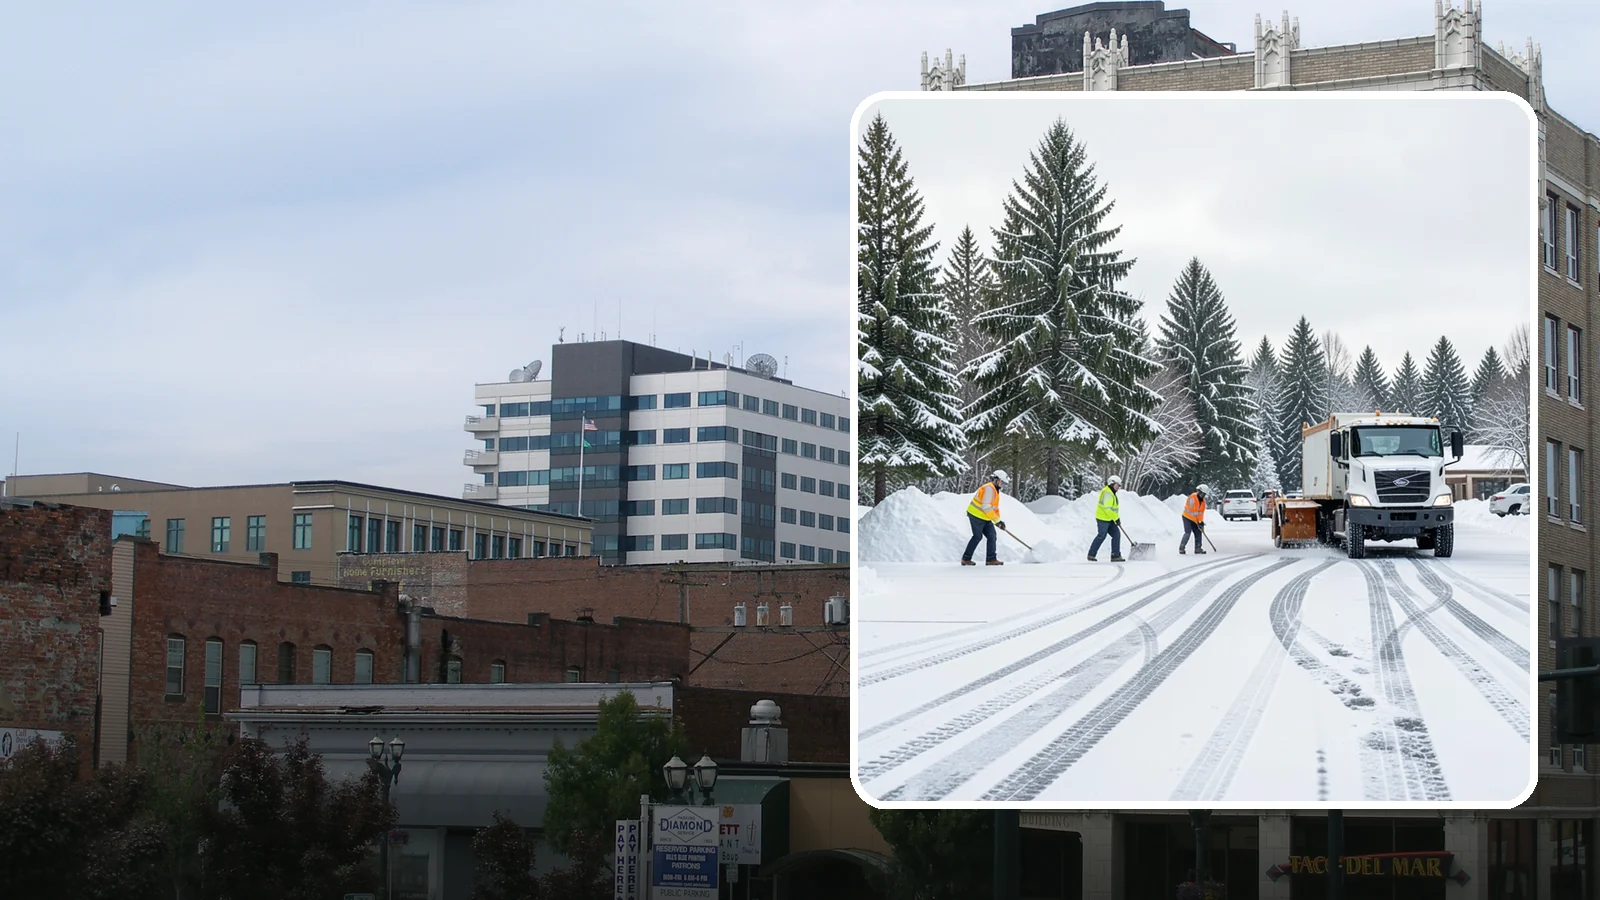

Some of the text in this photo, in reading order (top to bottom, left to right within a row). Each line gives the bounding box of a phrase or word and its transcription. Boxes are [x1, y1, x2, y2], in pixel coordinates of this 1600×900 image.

[370, 566, 427, 576] Furnishers
[660, 818, 713, 832] DIAMOND
[1022, 815, 1070, 828] BUILDING
[719, 824, 740, 835] ETT
[617, 825, 625, 852] PAY
[628, 824, 637, 852] PAY
[656, 845, 688, 853] RESERVED
[721, 851, 739, 861] Soup
[671, 862, 701, 870] PATRONS
[1289, 855, 1442, 877] TAC DEL MAR
[617, 856, 625, 894] HERE
[628, 855, 636, 893] HERE
[660, 888, 710, 898] PUBLIC PARKING
